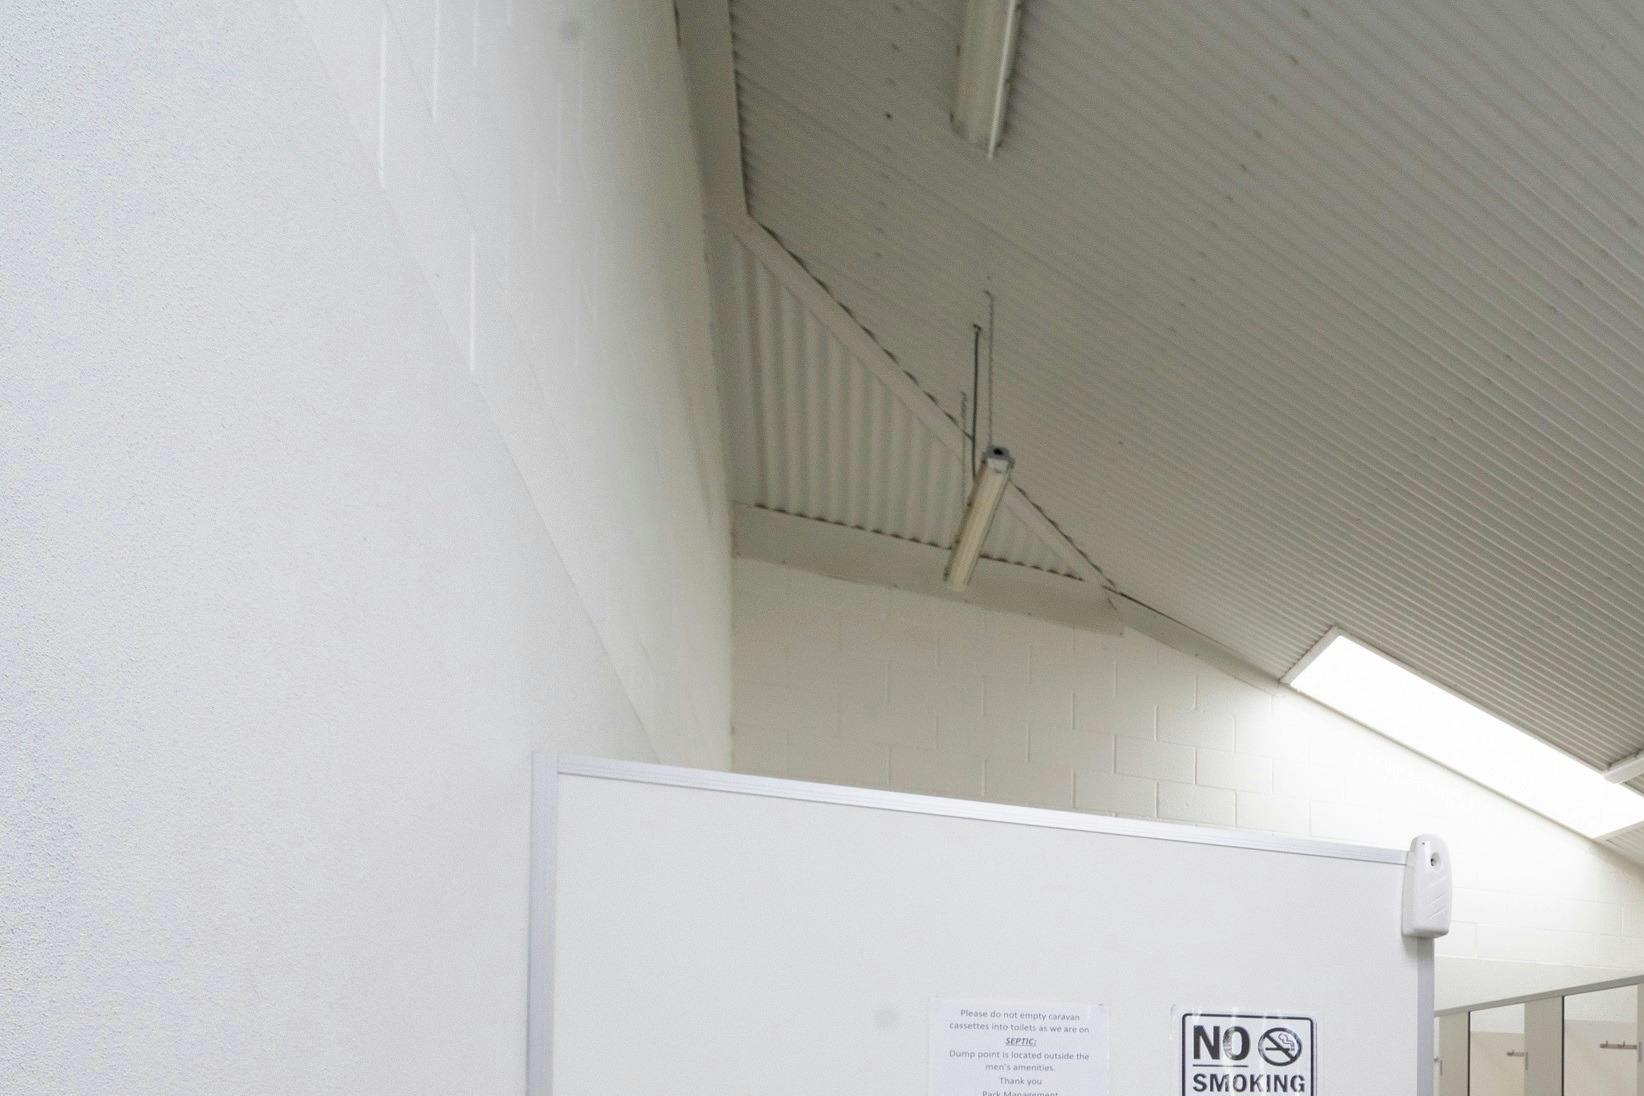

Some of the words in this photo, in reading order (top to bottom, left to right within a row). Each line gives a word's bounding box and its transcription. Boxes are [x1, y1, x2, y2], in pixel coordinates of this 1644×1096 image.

[960, 1009, 988, 1018] Please
[990, 1010, 1001, 1019] do
[1004, 1011, 1018, 1019] not
[1019, 1012, 1047, 1021] empty
[1048, 1013, 1080, 1021] caravan
[949, 1022, 989, 1030] cassettes
[991, 1023, 1008, 1031] into
[1010, 1024, 1037, 1032] toilets
[1193, 1025, 1250, 1061] NO
[949, 1050, 976, 1059] Dump
[978, 1050, 1000, 1059] point
[1002, 1051, 1009, 1059] is
[1011, 1051, 1042, 1059] located
[1044, 1052, 1075, 1060] outside
[1193, 1073, 1305, 1093] SMOKING
